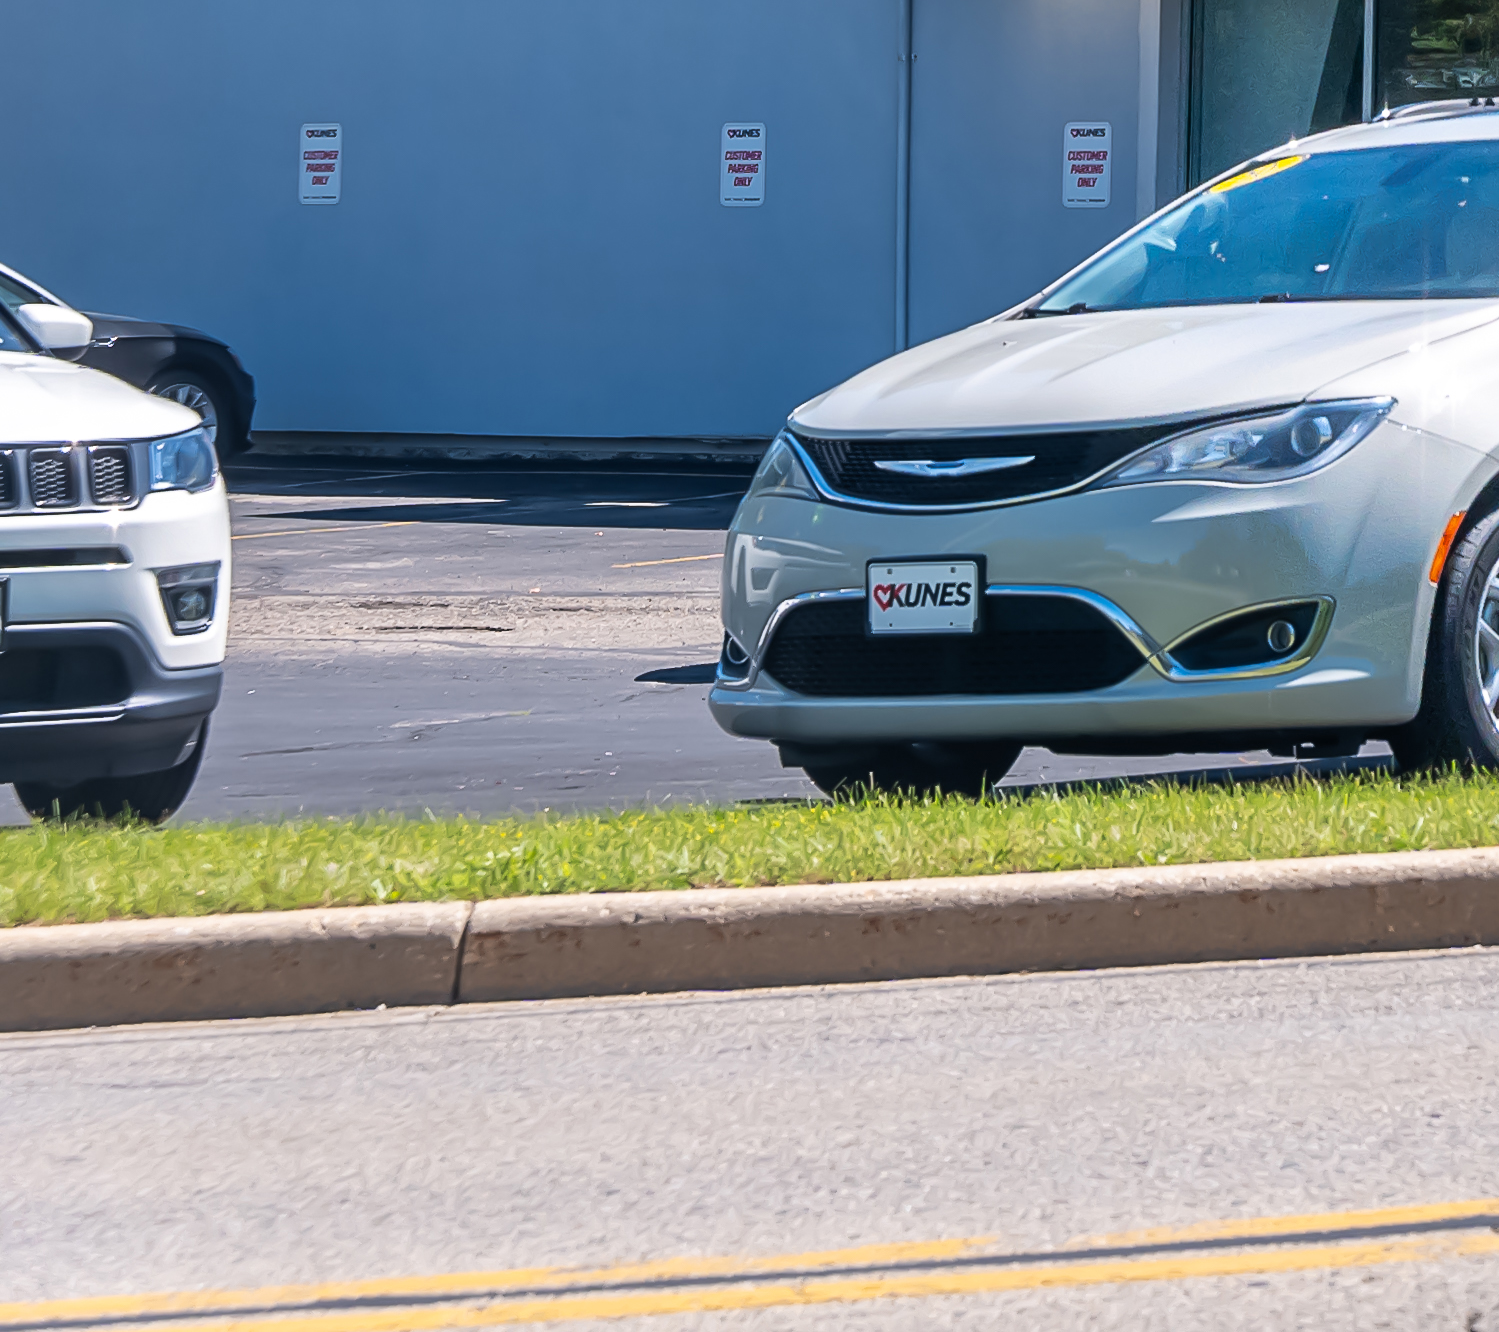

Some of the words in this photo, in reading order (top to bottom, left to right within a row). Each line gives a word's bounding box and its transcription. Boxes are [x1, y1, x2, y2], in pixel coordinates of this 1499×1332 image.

[1067, 150, 1108, 162] CUSTOMER
[1077, 177, 1098, 188] ONLY
[888, 581, 972, 608] KUNES
